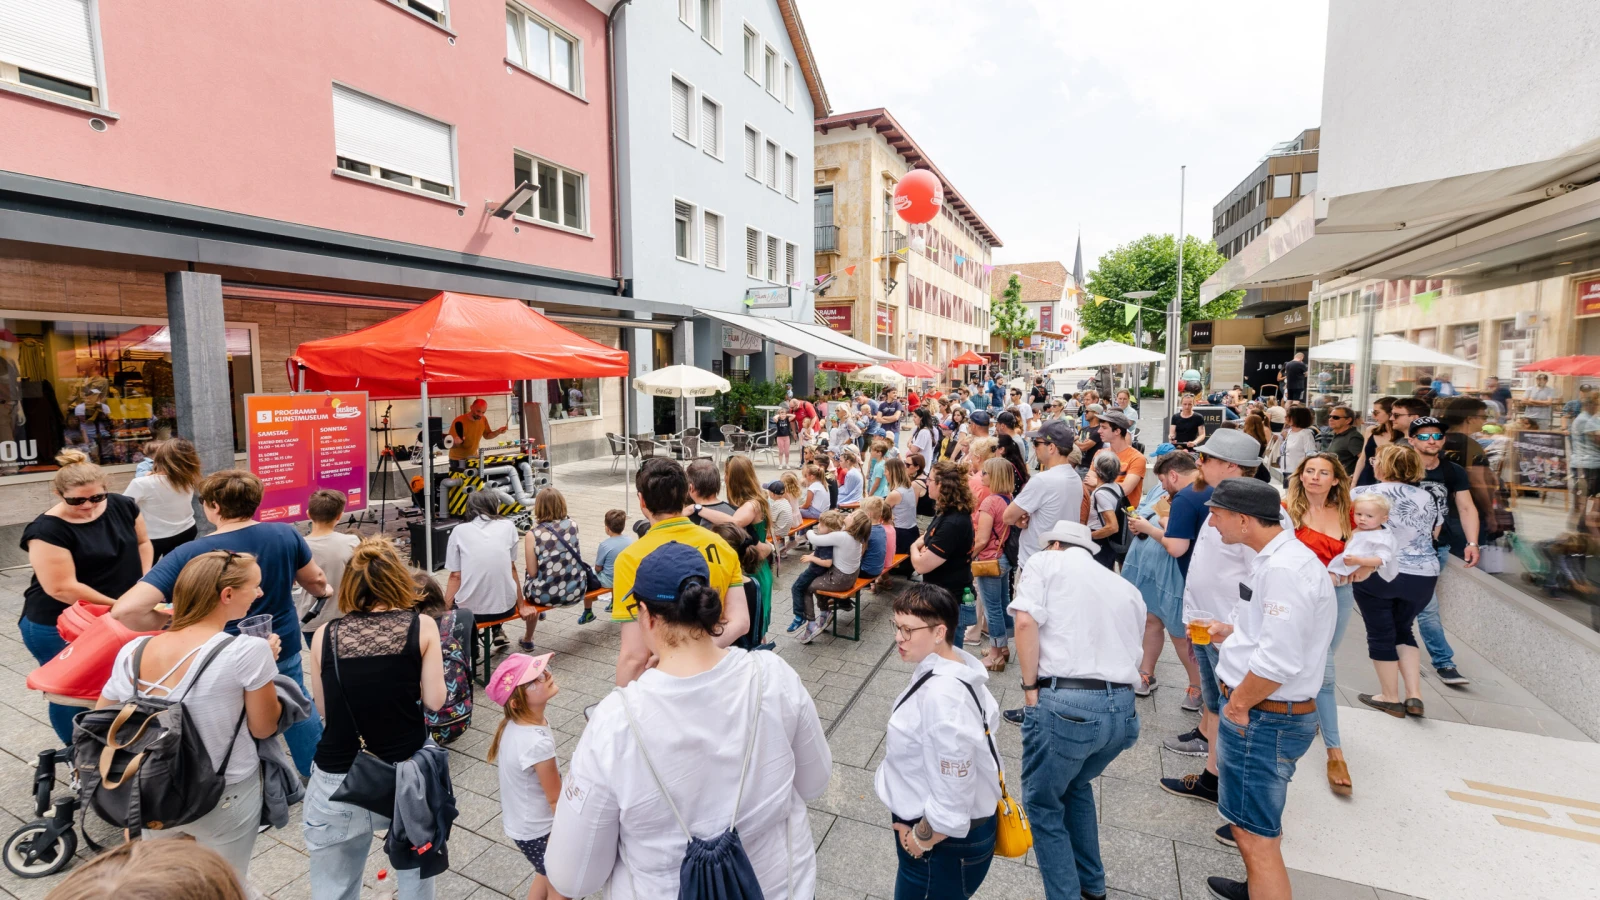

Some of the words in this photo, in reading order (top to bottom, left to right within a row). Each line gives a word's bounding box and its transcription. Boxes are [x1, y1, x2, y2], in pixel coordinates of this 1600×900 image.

[1256, 362, 1283, 371] Jone
[275, 414, 328, 422] KUNSTMUSEUM
[0, 439, 38, 462] OU
